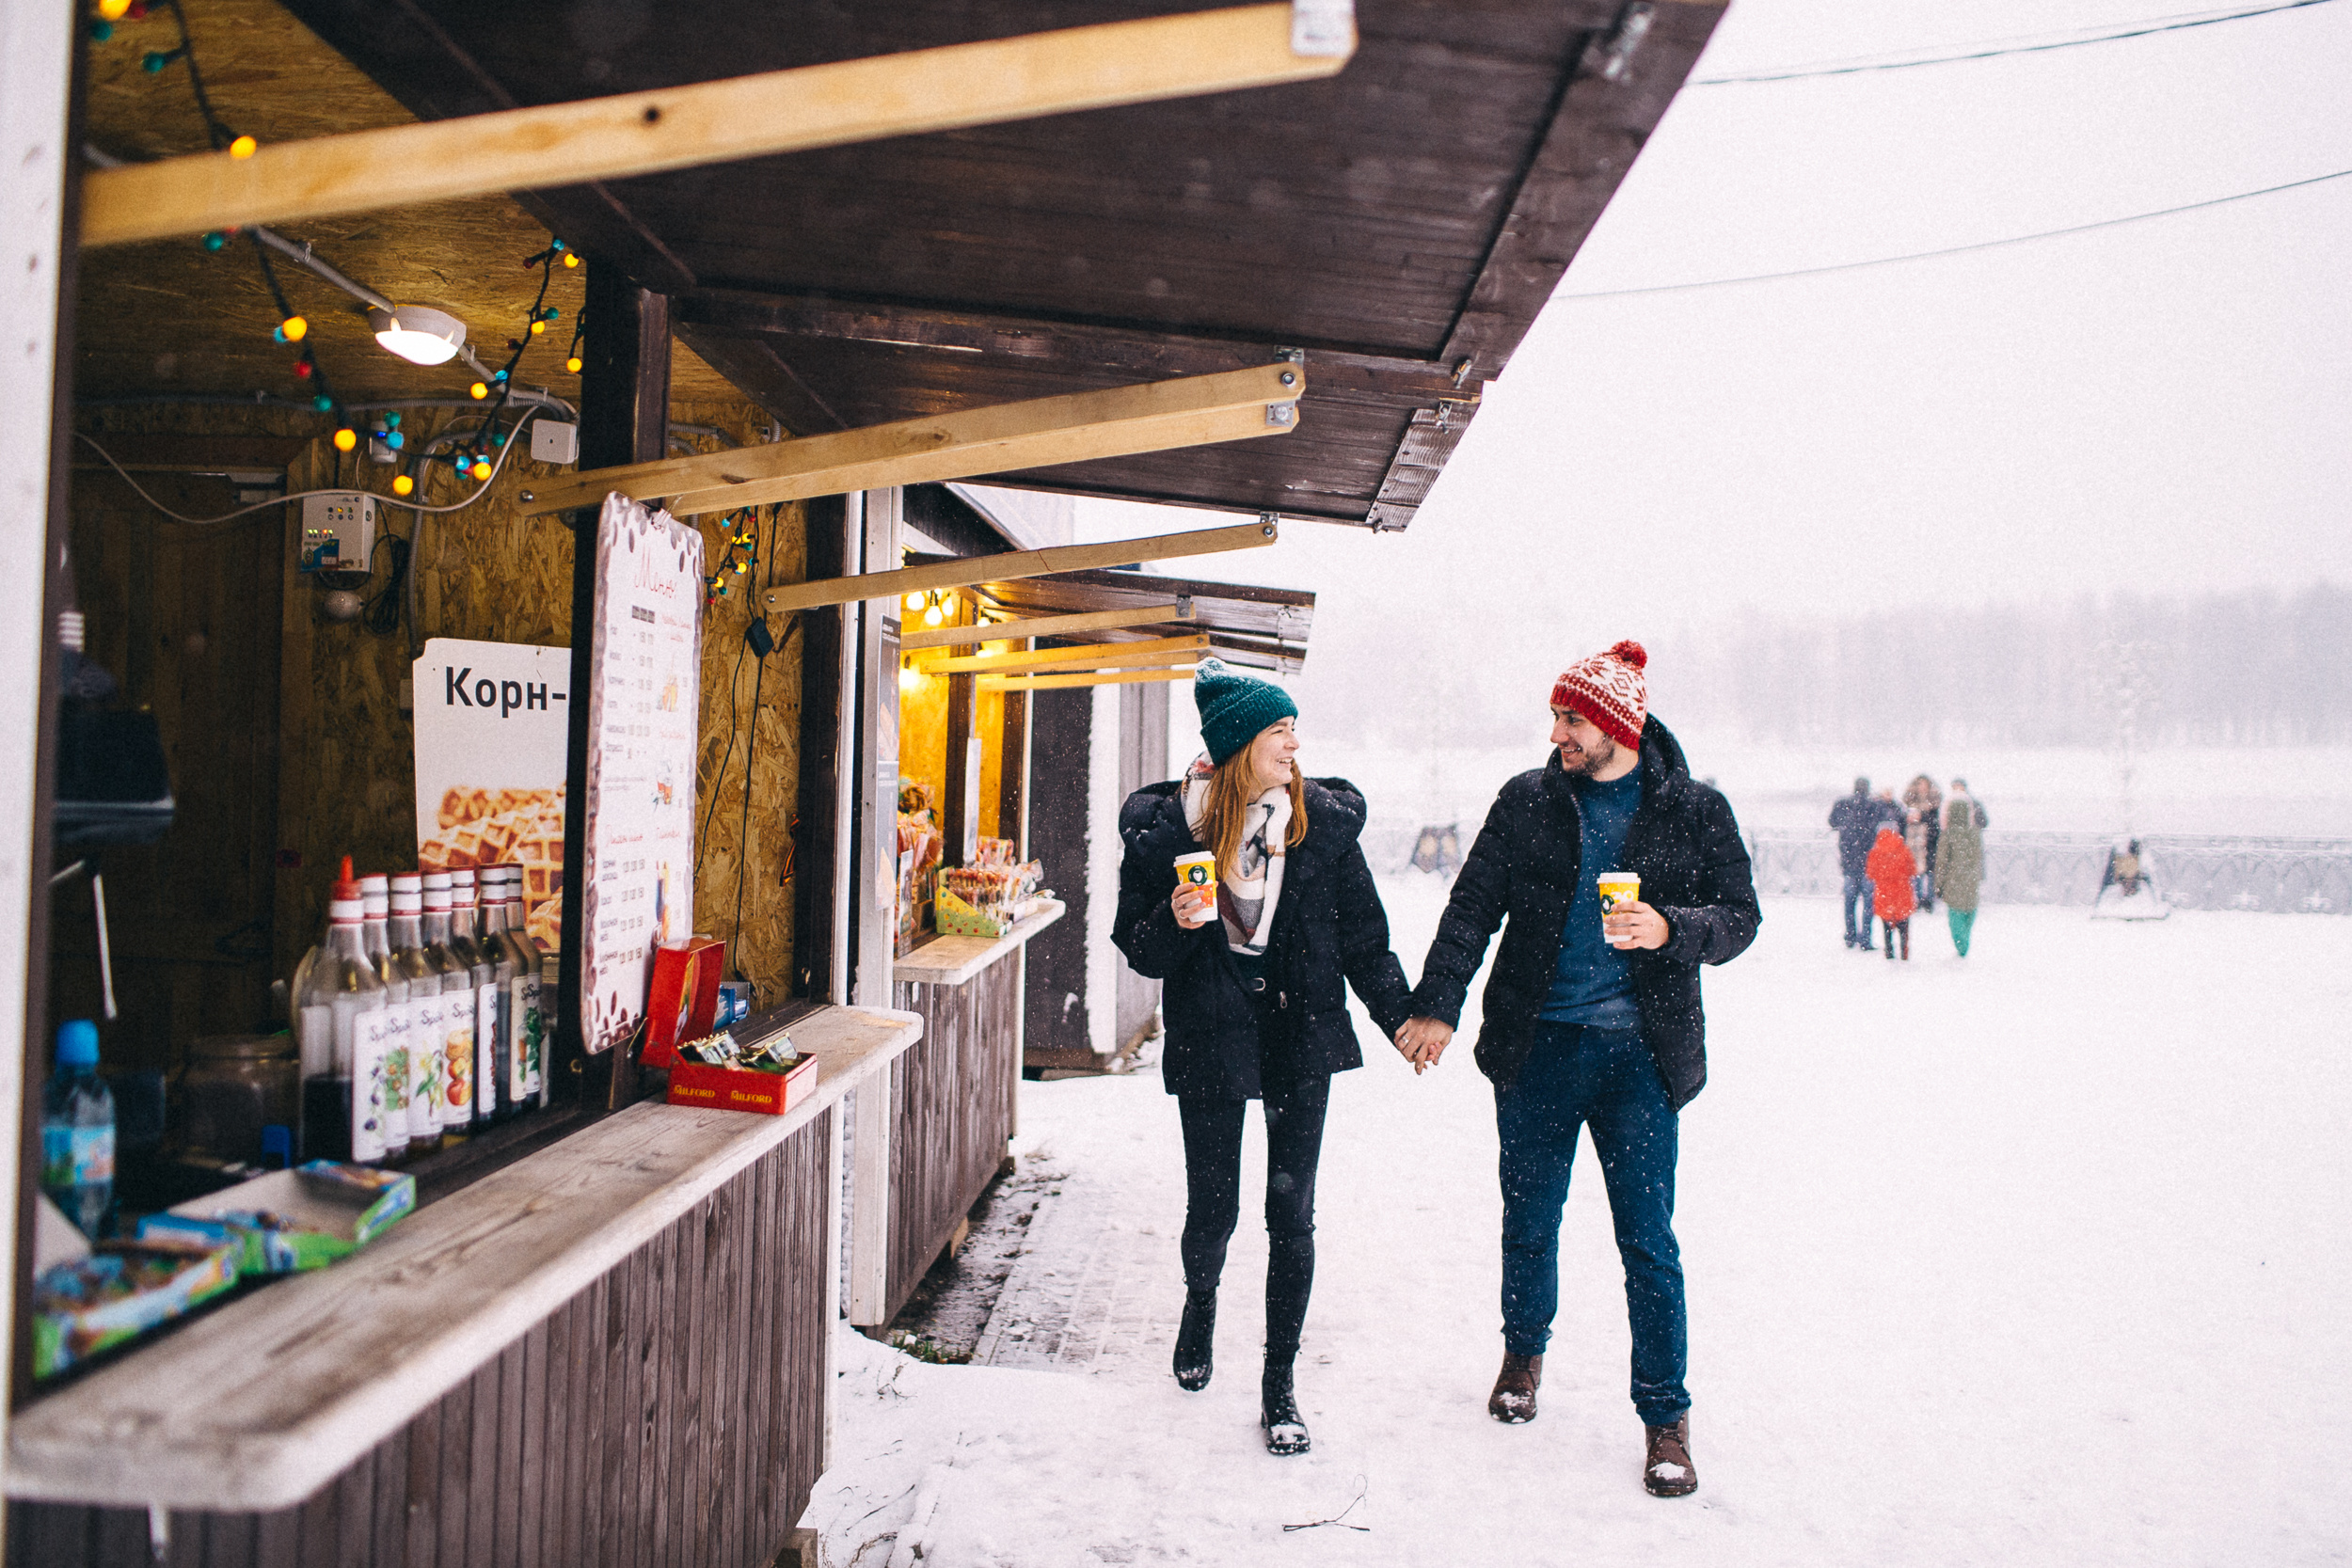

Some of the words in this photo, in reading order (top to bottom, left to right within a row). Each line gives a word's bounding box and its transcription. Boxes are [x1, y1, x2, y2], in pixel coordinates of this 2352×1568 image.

[445, 666, 567, 719] Корн-
[674, 1085, 716, 1099] MILFORD
[731, 1090, 773, 1103] MILFORD
